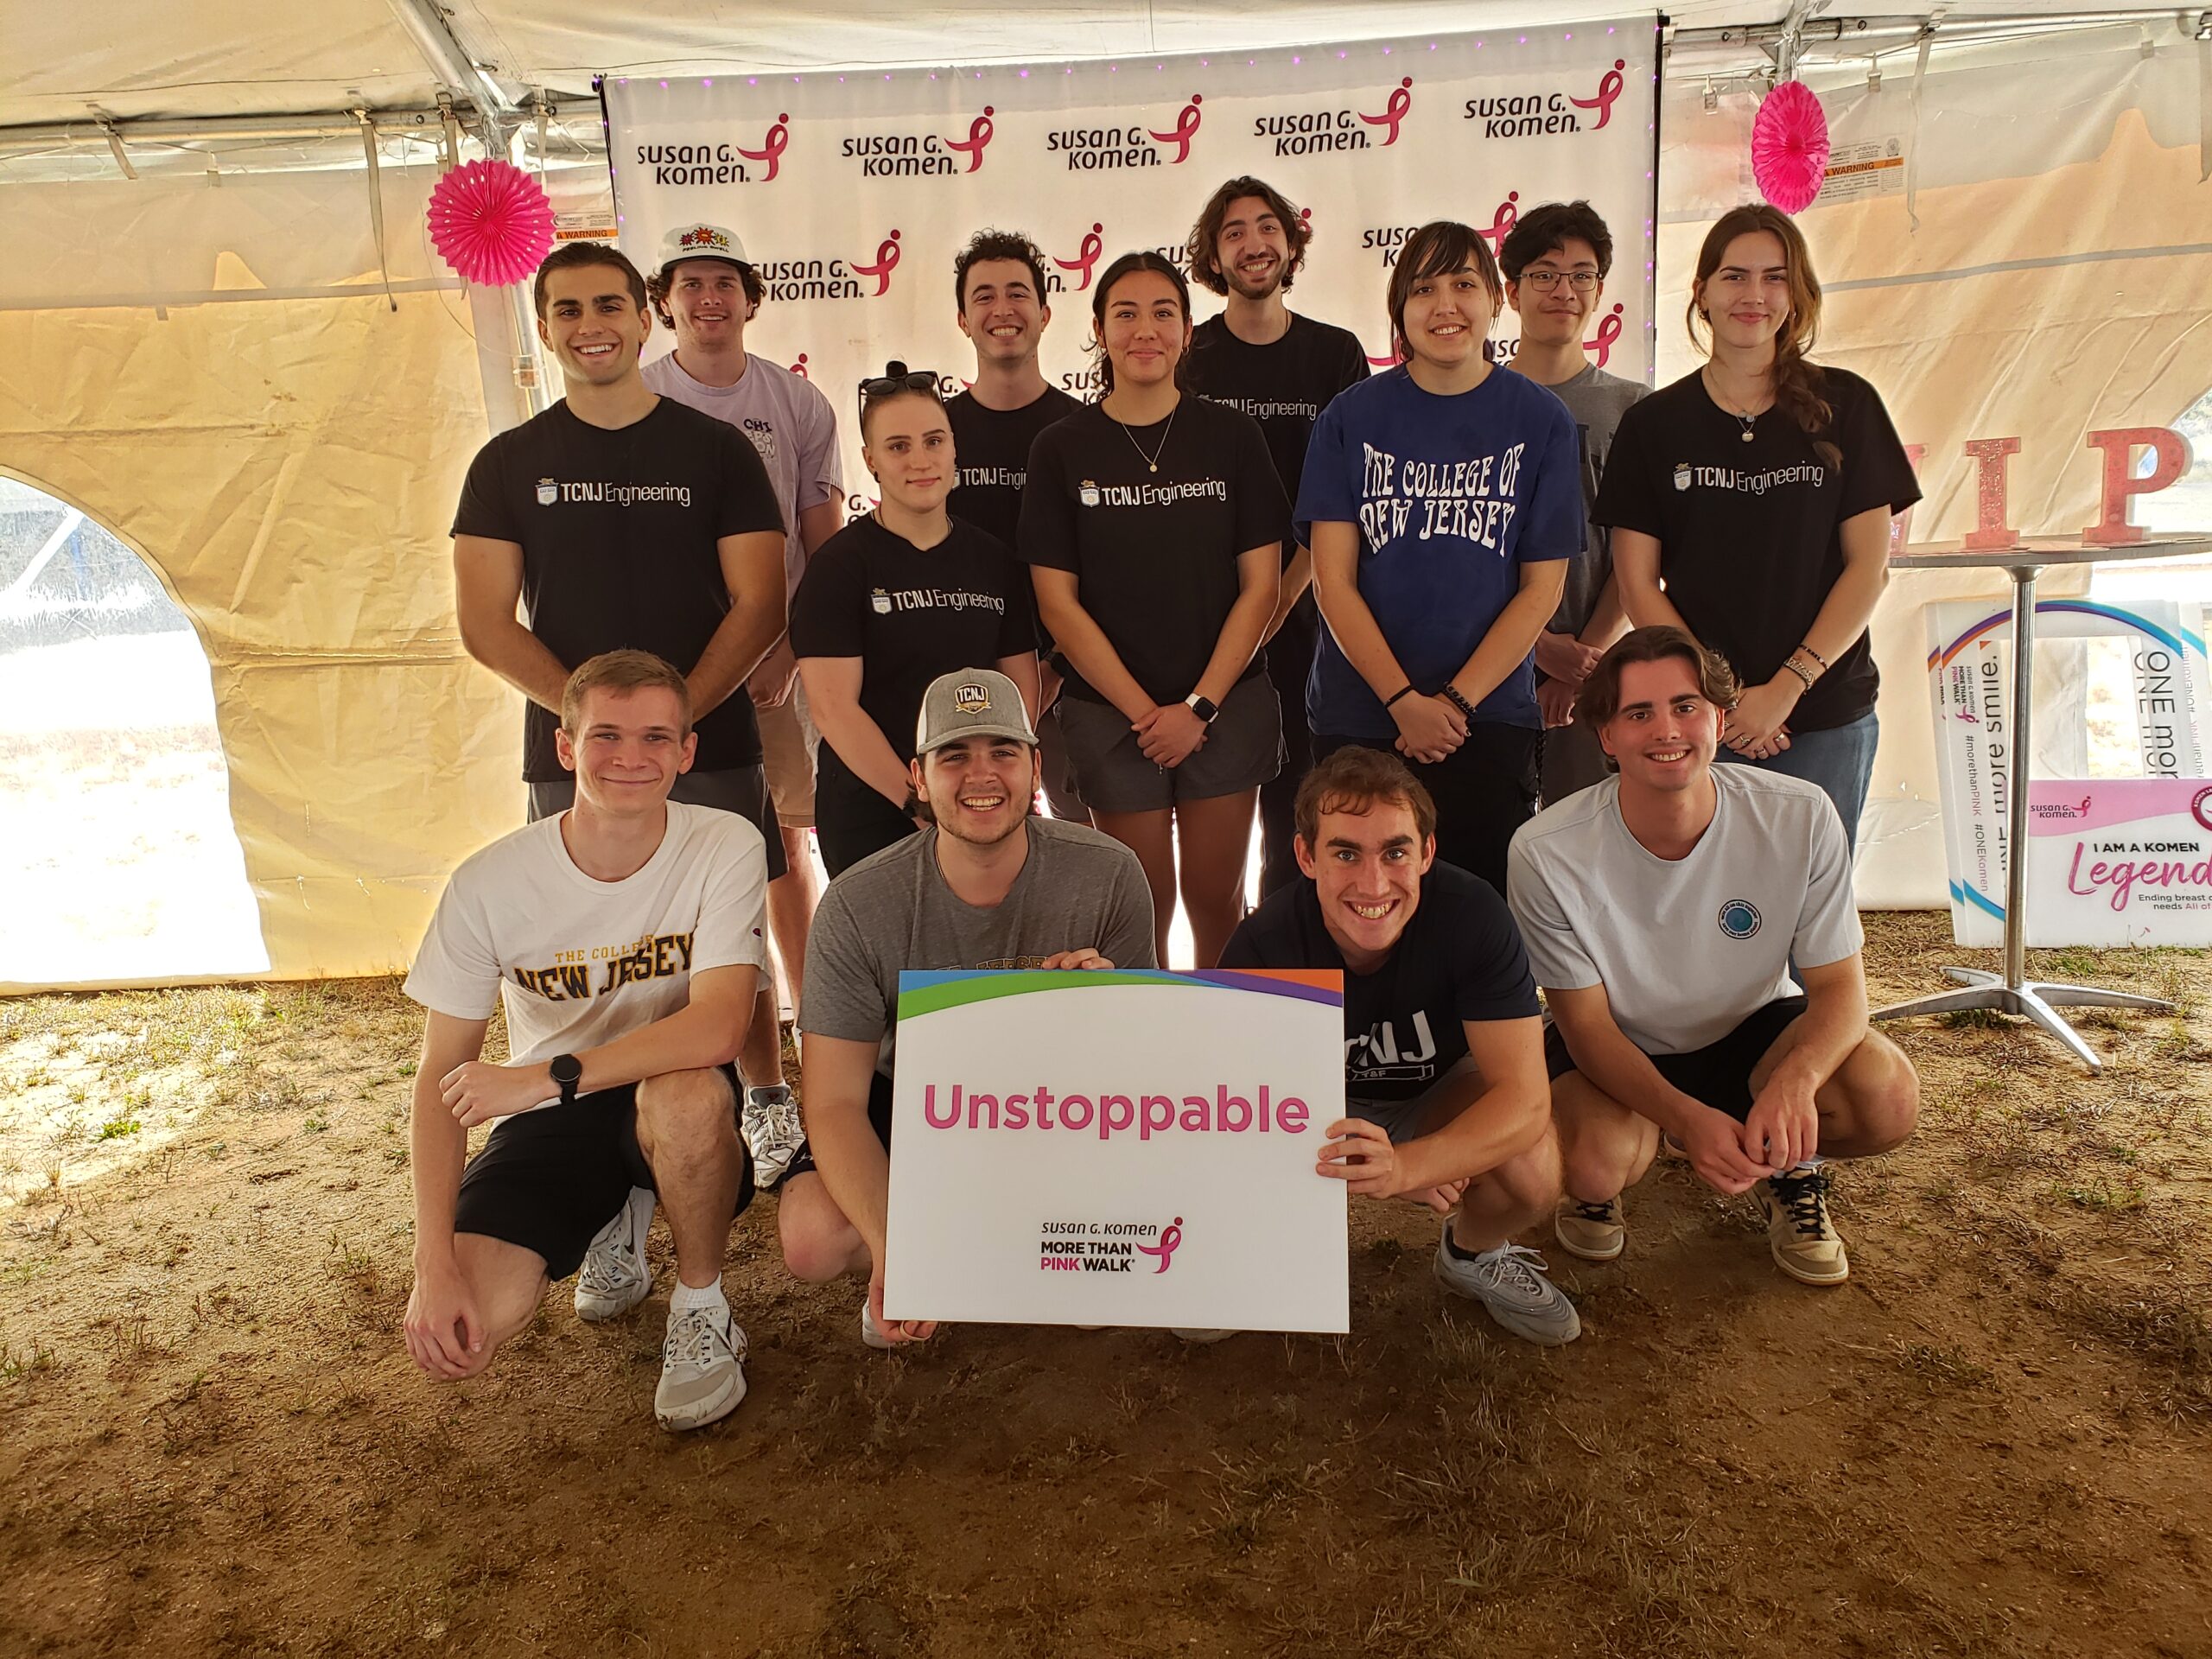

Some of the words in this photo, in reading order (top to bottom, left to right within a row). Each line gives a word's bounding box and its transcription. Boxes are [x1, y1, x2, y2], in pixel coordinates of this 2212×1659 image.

[1548, 93, 1567, 112] G.
[1337, 110, 1356, 129] G.
[923, 135, 943, 154] G.
[1127, 126, 1147, 146] G.
[716, 144, 734, 162] G.
[1832, 162, 1874, 176] WARNING
[564, 229, 607, 239] WARNING
[829, 260, 849, 278] G.
[1247, 397, 1318, 421] Engineering
[963, 467, 997, 486] TCNJ
[1362, 442, 1395, 498] THE
[1402, 455, 1495, 498] COLLEGE
[1499, 442, 1525, 498] OF
[1694, 467, 1734, 489] TCNJ
[1736, 460, 1824, 495] Engineering
[561, 482, 603, 502] TCNJ
[1102, 486, 1141, 506] TCNJ
[1141, 476, 1226, 506] Engineering
[848, 493, 867, 511] G.
[1359, 499, 1414, 555] NEW
[1419, 499, 1516, 557] JERSEY
[893, 589, 933, 612] TCNJ
[932, 588, 1004, 615] Engineering
[2147, 652, 2176, 714] ONE
[957, 687, 985, 702] TCNJ
[1965, 735, 1983, 816] #morethanPINK
[2094, 843, 2098, 853] I
[2102, 843, 2126, 853] AM
[2129, 843, 2141, 853] A
[2145, 842, 2200, 853] KOMEN
[2139, 894, 2172, 903] Ending
[555, 950, 585, 963] THE
[514, 963, 593, 1001] NEW
[924, 1084, 1310, 1141] Unstoppable
[1090, 1223, 1101, 1235] G.
[1041, 1241, 1085, 1254] MORE
[1088, 1242, 1132, 1255] THAN
[1040, 1257, 1080, 1271] PINK
